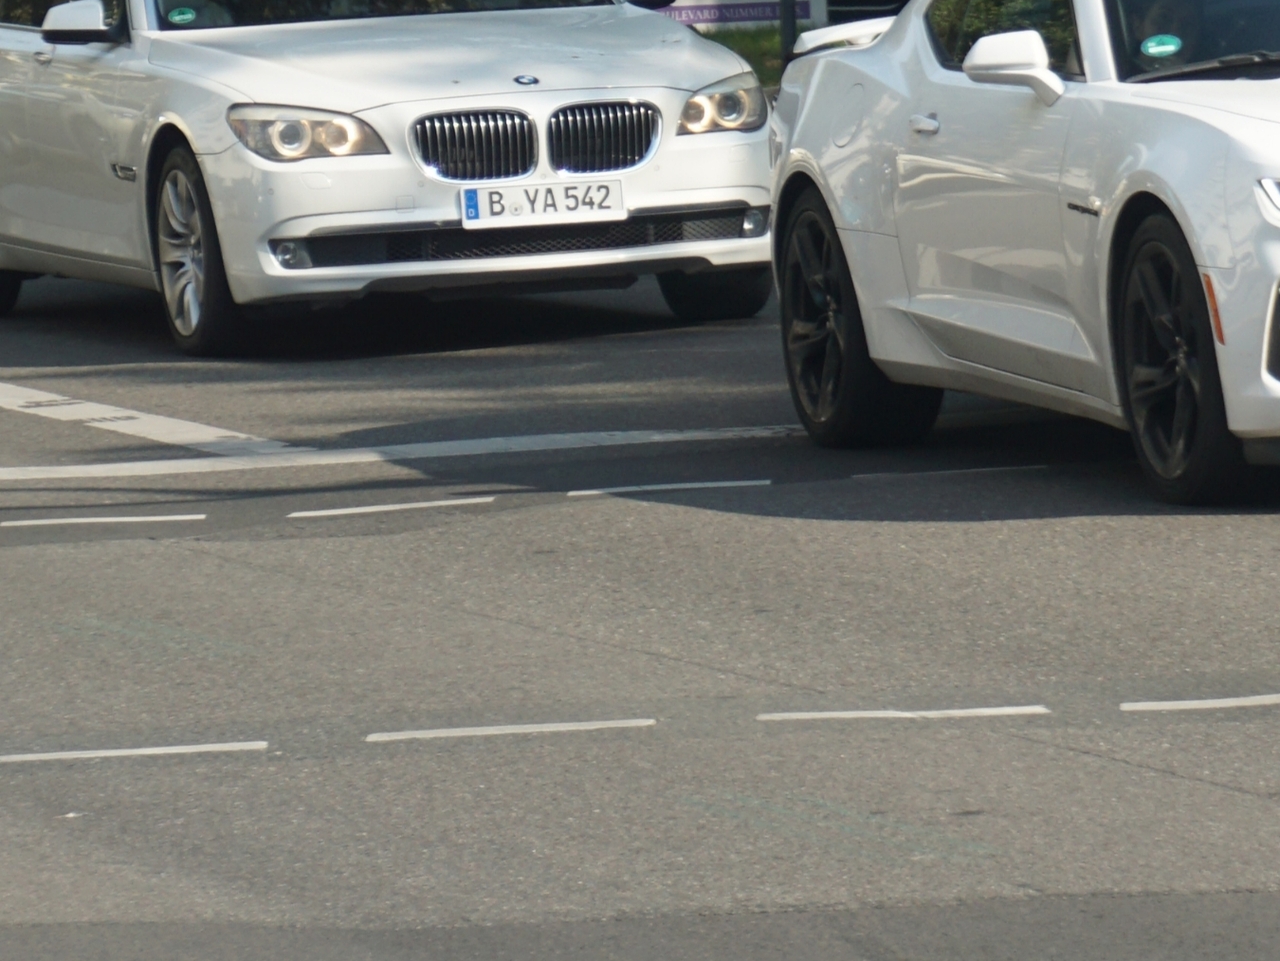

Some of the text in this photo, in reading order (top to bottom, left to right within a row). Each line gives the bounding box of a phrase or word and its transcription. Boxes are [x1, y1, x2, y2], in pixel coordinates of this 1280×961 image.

[721, 7, 775, 20] NUMMER
[488, 184, 612, 217] B YA 542
